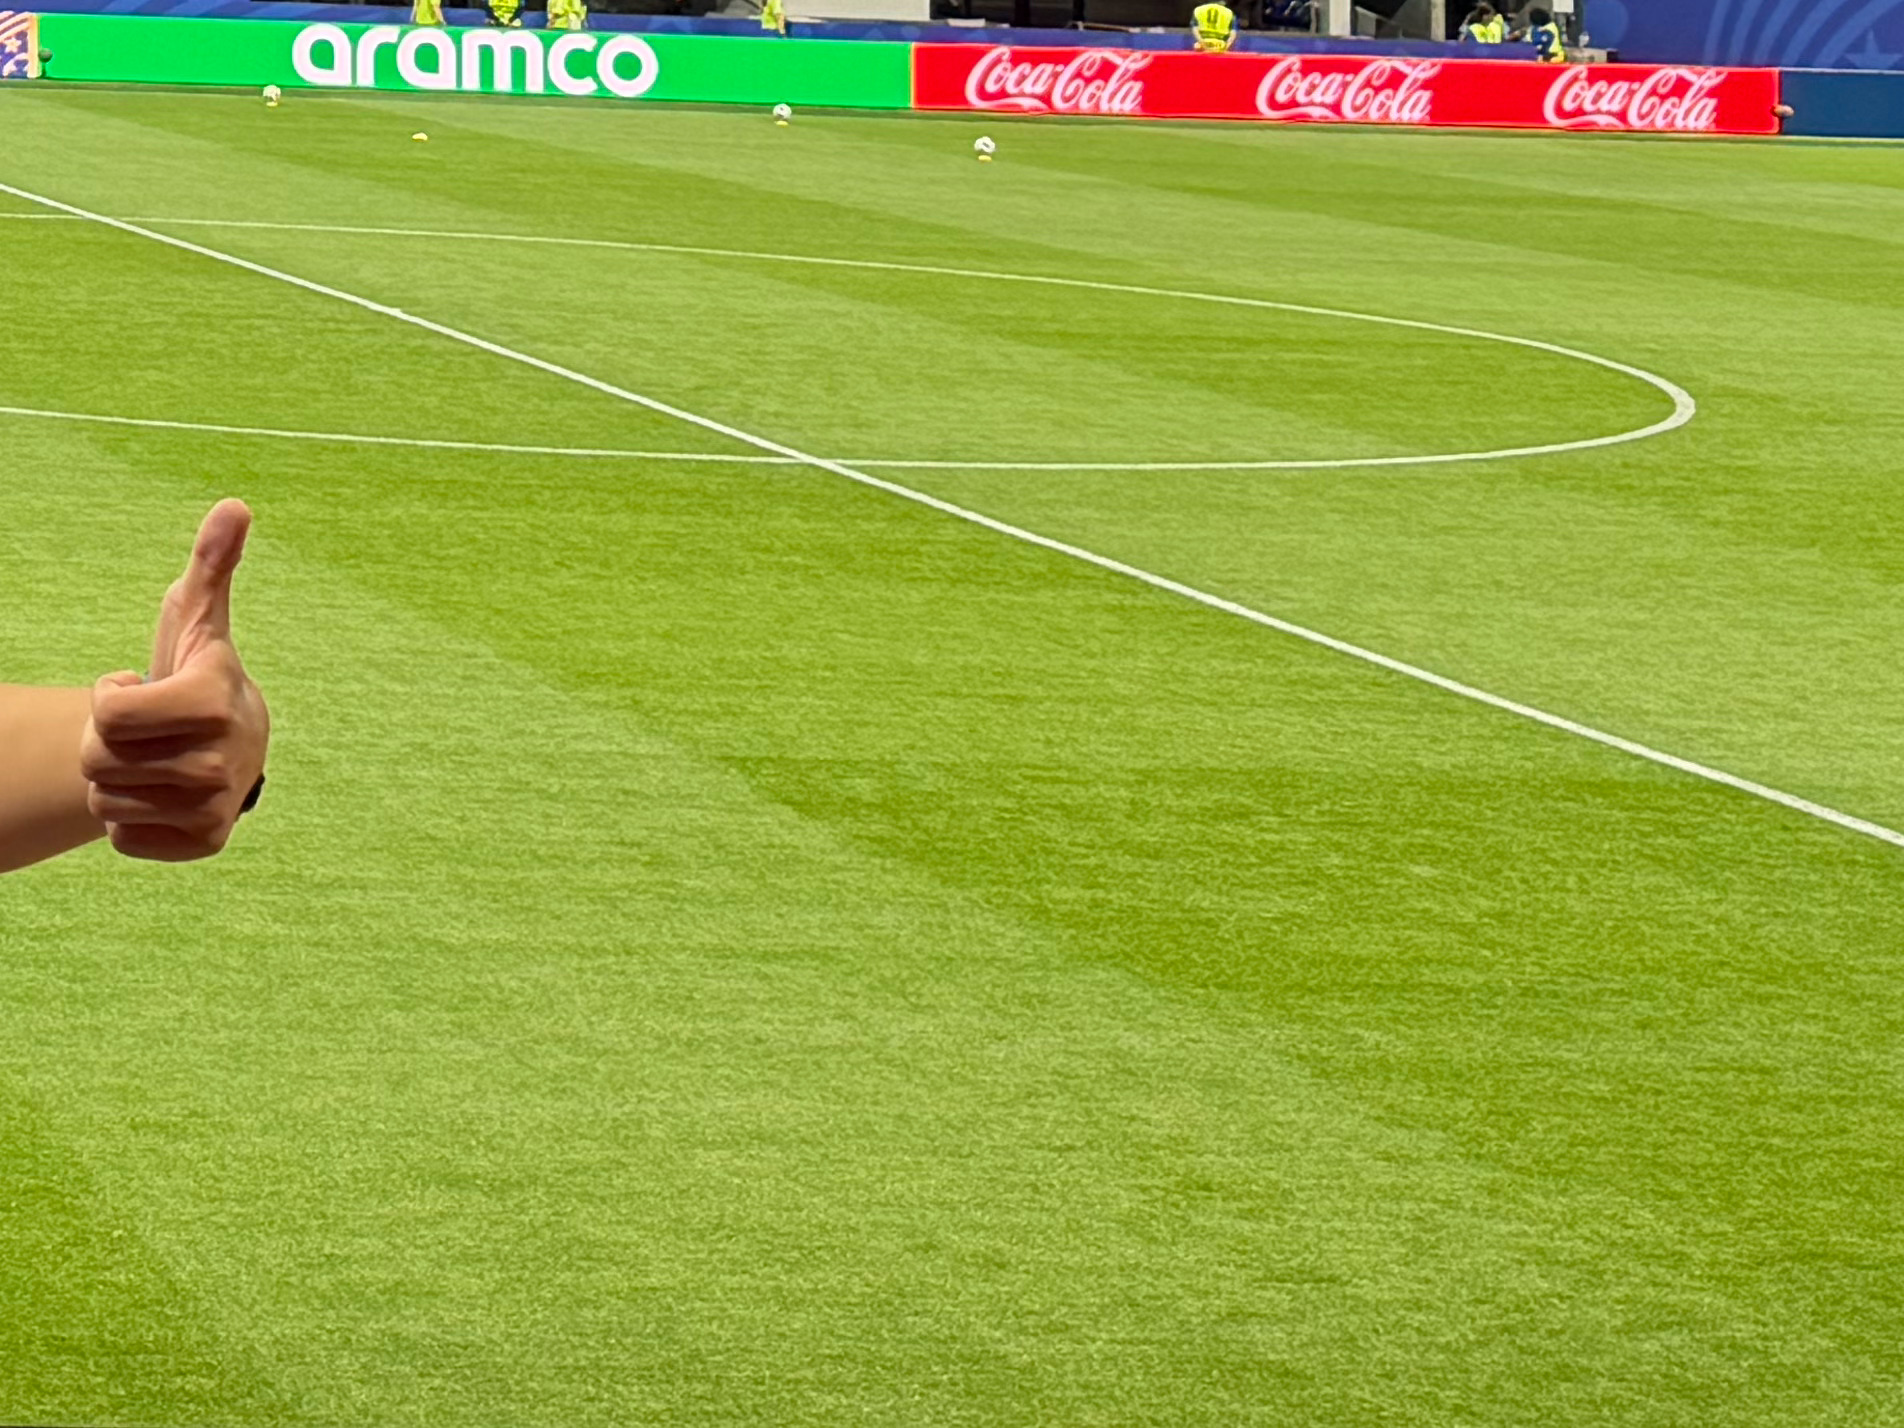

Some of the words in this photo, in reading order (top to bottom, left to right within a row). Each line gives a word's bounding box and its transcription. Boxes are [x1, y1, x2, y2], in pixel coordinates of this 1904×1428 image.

[292, 24, 659, 97] aramco
[965, 47, 1153, 113] Coca-Cola
[1255, 56, 1441, 121] Coca-Cola
[1543, 66, 1728, 129] Coca-Cola
